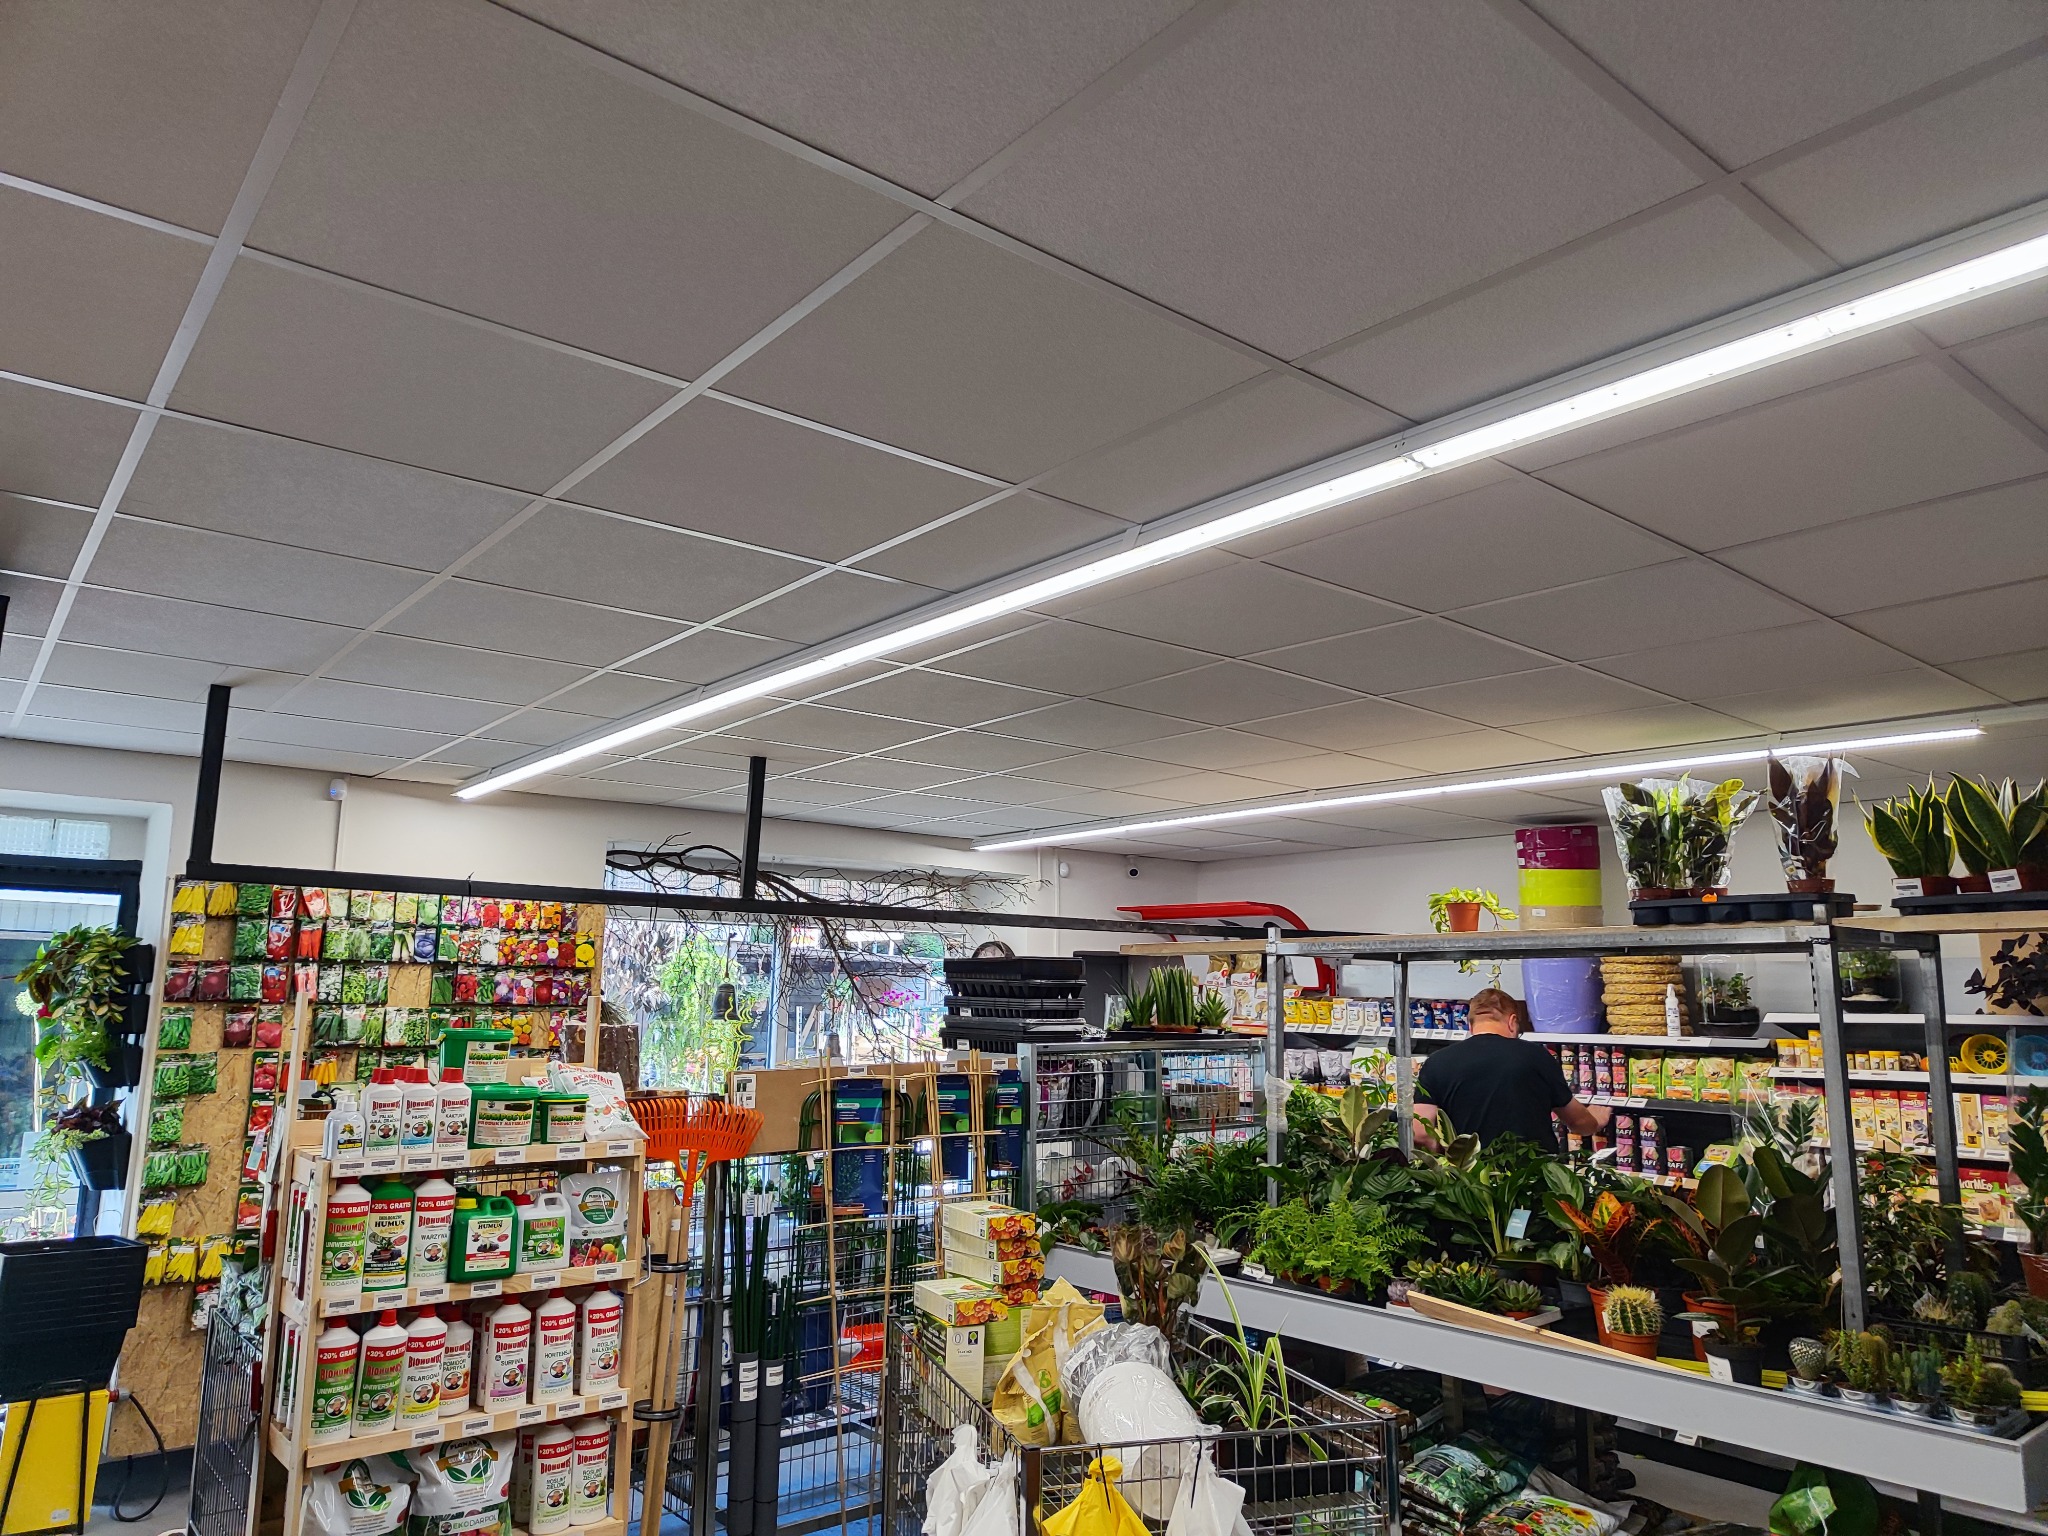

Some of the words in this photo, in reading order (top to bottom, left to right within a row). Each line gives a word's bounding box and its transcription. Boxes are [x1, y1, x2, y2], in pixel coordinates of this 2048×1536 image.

[372, 1099, 400, 1111] BIOHUMUS
[406, 1097, 435, 1109] BIOHUMUS
[441, 1097, 469, 1108] BIOHUMUS
[347, 1204, 368, 1213] GRATIS
[390, 1201, 411, 1209] GRATIS
[374, 1220, 405, 1228] HUMUS
[418, 1213, 452, 1227] BIOHUMUS
[328, 1220, 365, 1234] BIOHUMUS
[322, 1279, 359, 1287] EKODARPOL
[496, 1337, 527, 1353] BIOHUMUS
[367, 1350, 384, 1358] +20%
[408, 1351, 442, 1369] BIOHUMUS
[577, 1448, 607, 1466] BIOHUMUS
[540, 1457, 571, 1474] BIOHUMUS
[452, 1514, 497, 1530] EKODARPOL
